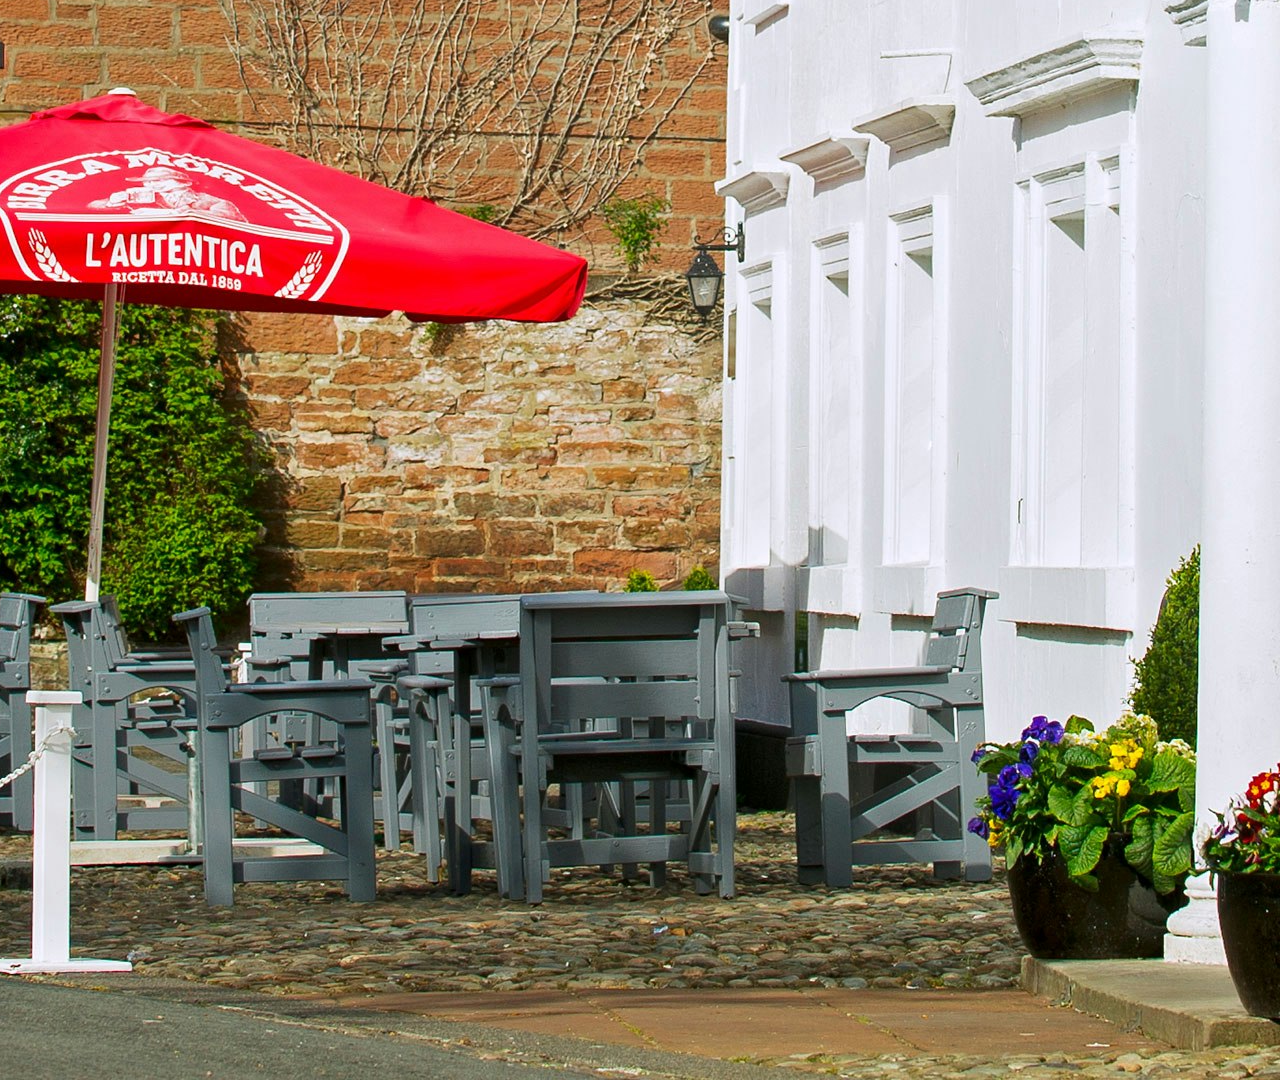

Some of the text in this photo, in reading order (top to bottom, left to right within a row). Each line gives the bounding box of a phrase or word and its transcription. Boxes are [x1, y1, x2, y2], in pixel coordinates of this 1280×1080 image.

[7, 158, 122, 210] BIRRA
[85, 232, 264, 278] L'AUTENTICA
[111, 271, 242, 291] RICETTA DAL 1859
